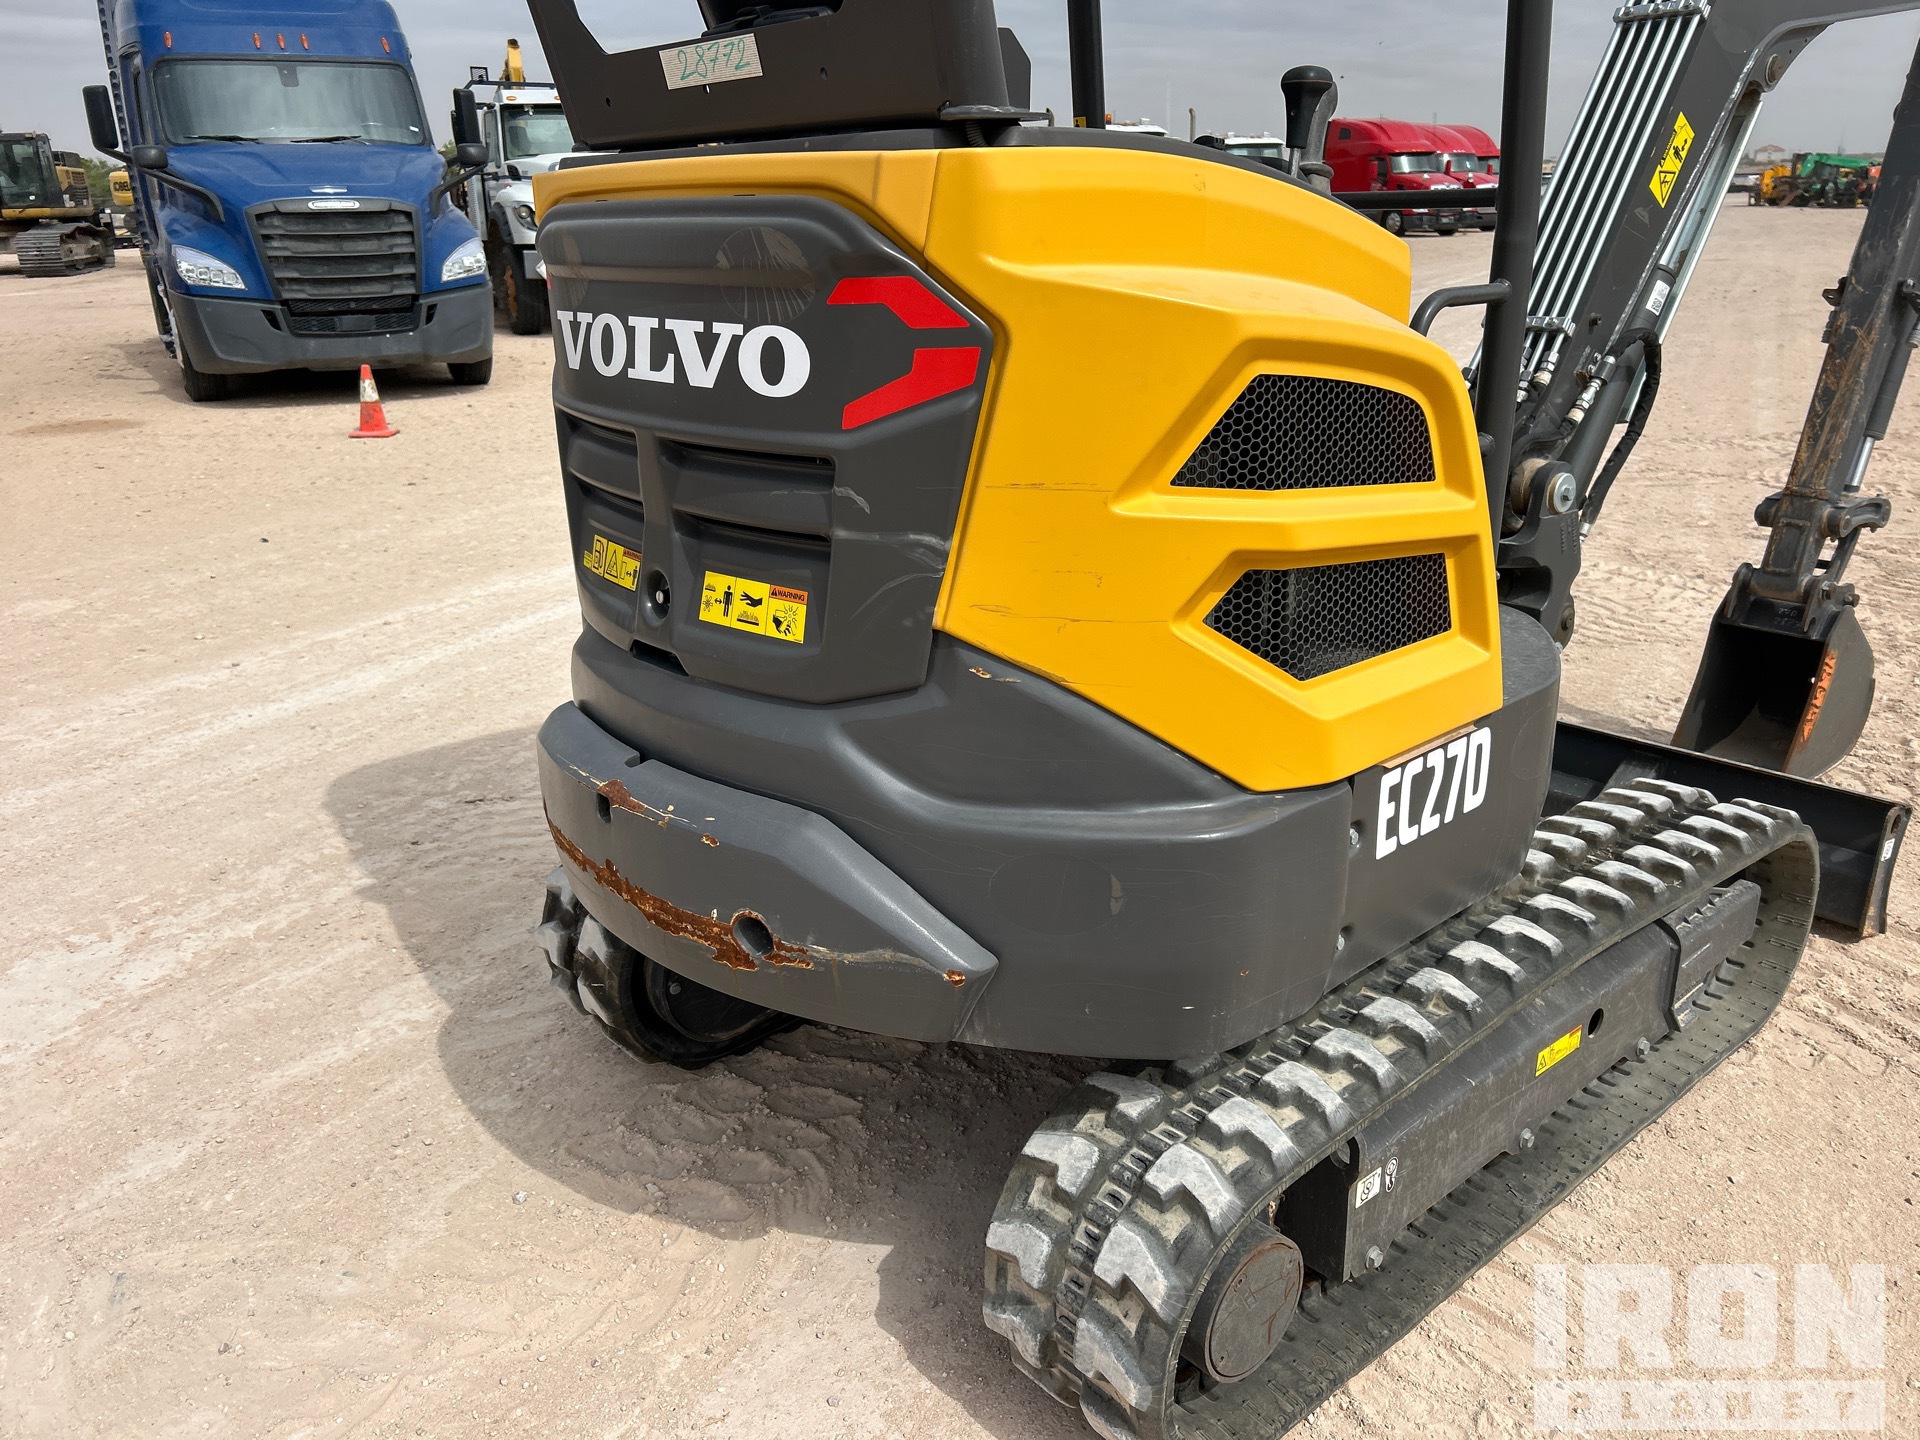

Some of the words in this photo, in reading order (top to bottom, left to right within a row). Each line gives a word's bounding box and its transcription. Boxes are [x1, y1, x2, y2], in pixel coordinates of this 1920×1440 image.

[677, 38, 751, 81] 28772
[557, 310, 811, 398] VOLVO
[777, 589, 805, 602] WARNING
[1376, 727, 1492, 860] EC27D
